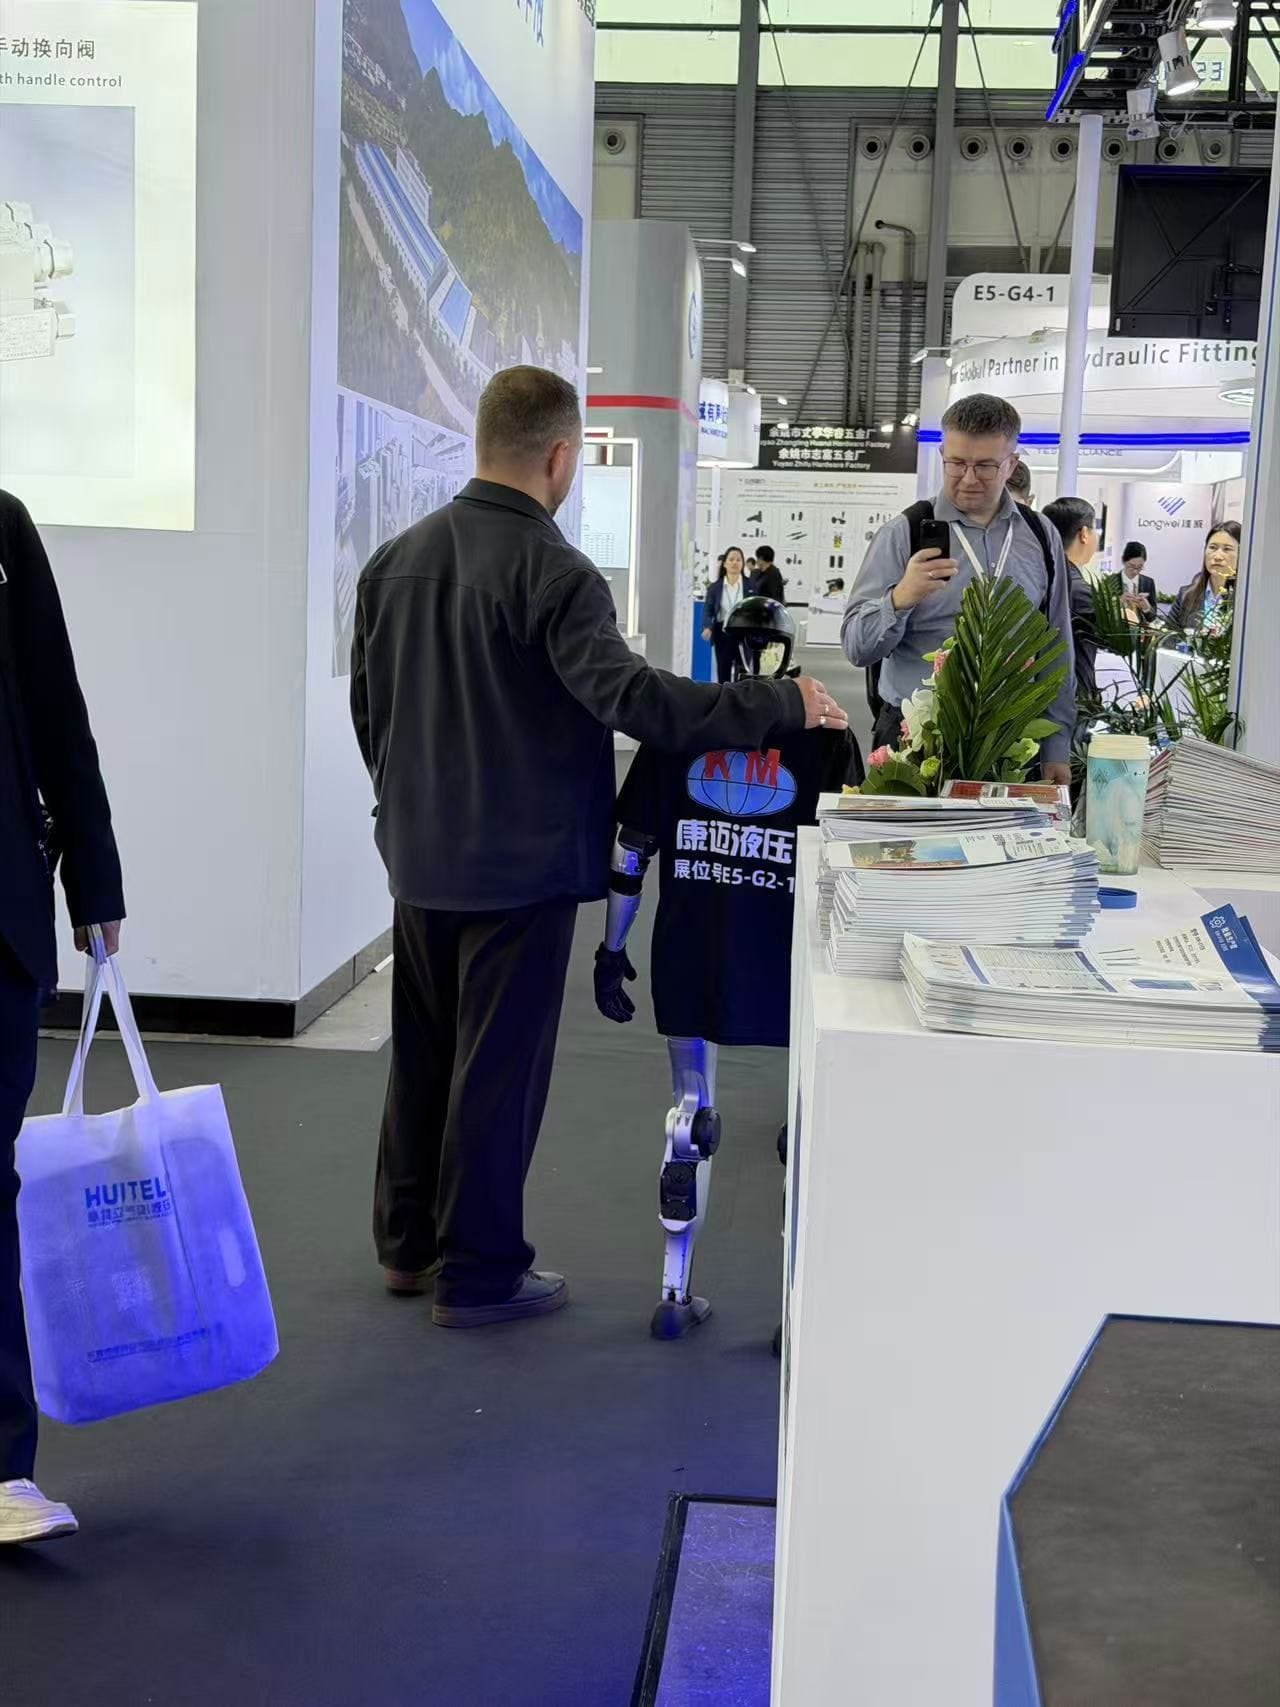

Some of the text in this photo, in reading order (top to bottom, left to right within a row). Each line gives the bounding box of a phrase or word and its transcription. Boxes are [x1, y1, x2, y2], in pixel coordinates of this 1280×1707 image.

[17, 72, 66, 86] handle
[69, 75, 122, 87] control
[974, 285, 1054, 301] E5-G4-1
[988, 357, 1039, 377] Partner
[1044, 352, 1058, 371] in
[1083, 344, 1170, 369] ydraulic
[866, 441, 891, 449] Factory
[845, 461, 871, 470] Factory
[1138, 518, 1180, 531] Longwei
[676, 819, 795, 865] 康迈液压
